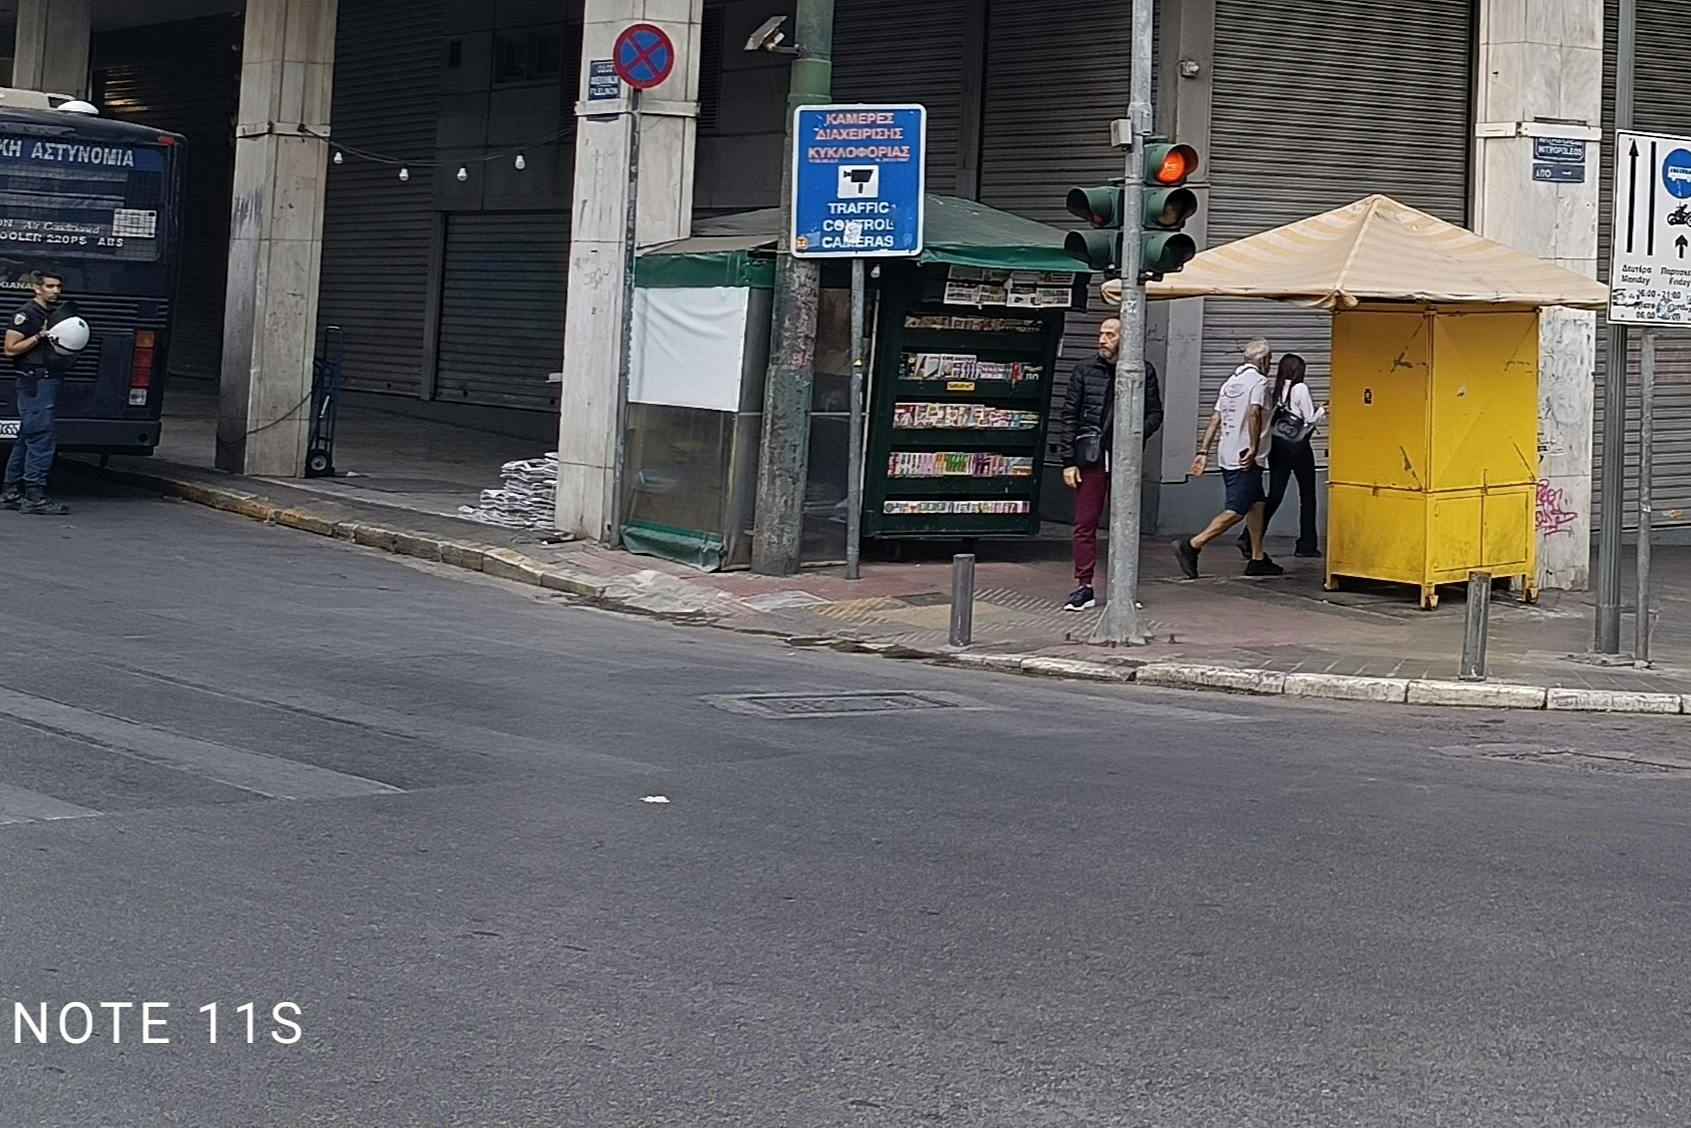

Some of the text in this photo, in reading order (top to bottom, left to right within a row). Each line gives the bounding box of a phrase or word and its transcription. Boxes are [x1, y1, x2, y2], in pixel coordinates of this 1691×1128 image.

[826, 112, 895, 124] ΚΑΜΕΡΕΣ
[815, 127, 904, 140] ΔΙΑΧΕΙΡΙΣΗΣ
[31, 141, 134, 168] ΑΣΤΥΝΟΜΙΑ
[808, 145, 910, 159] ΚΥΚΛΟΦΟΡΙΑΣ
[828, 202, 890, 214] TRAFFIC
[46, 234, 88, 246] 220PS
[97, 237, 125, 248] ABS
[1622, 264, 1652, 274] Δευτέρα
[1621, 275, 1651, 286] Monday
[1669, 277, 1691, 287] Friday
